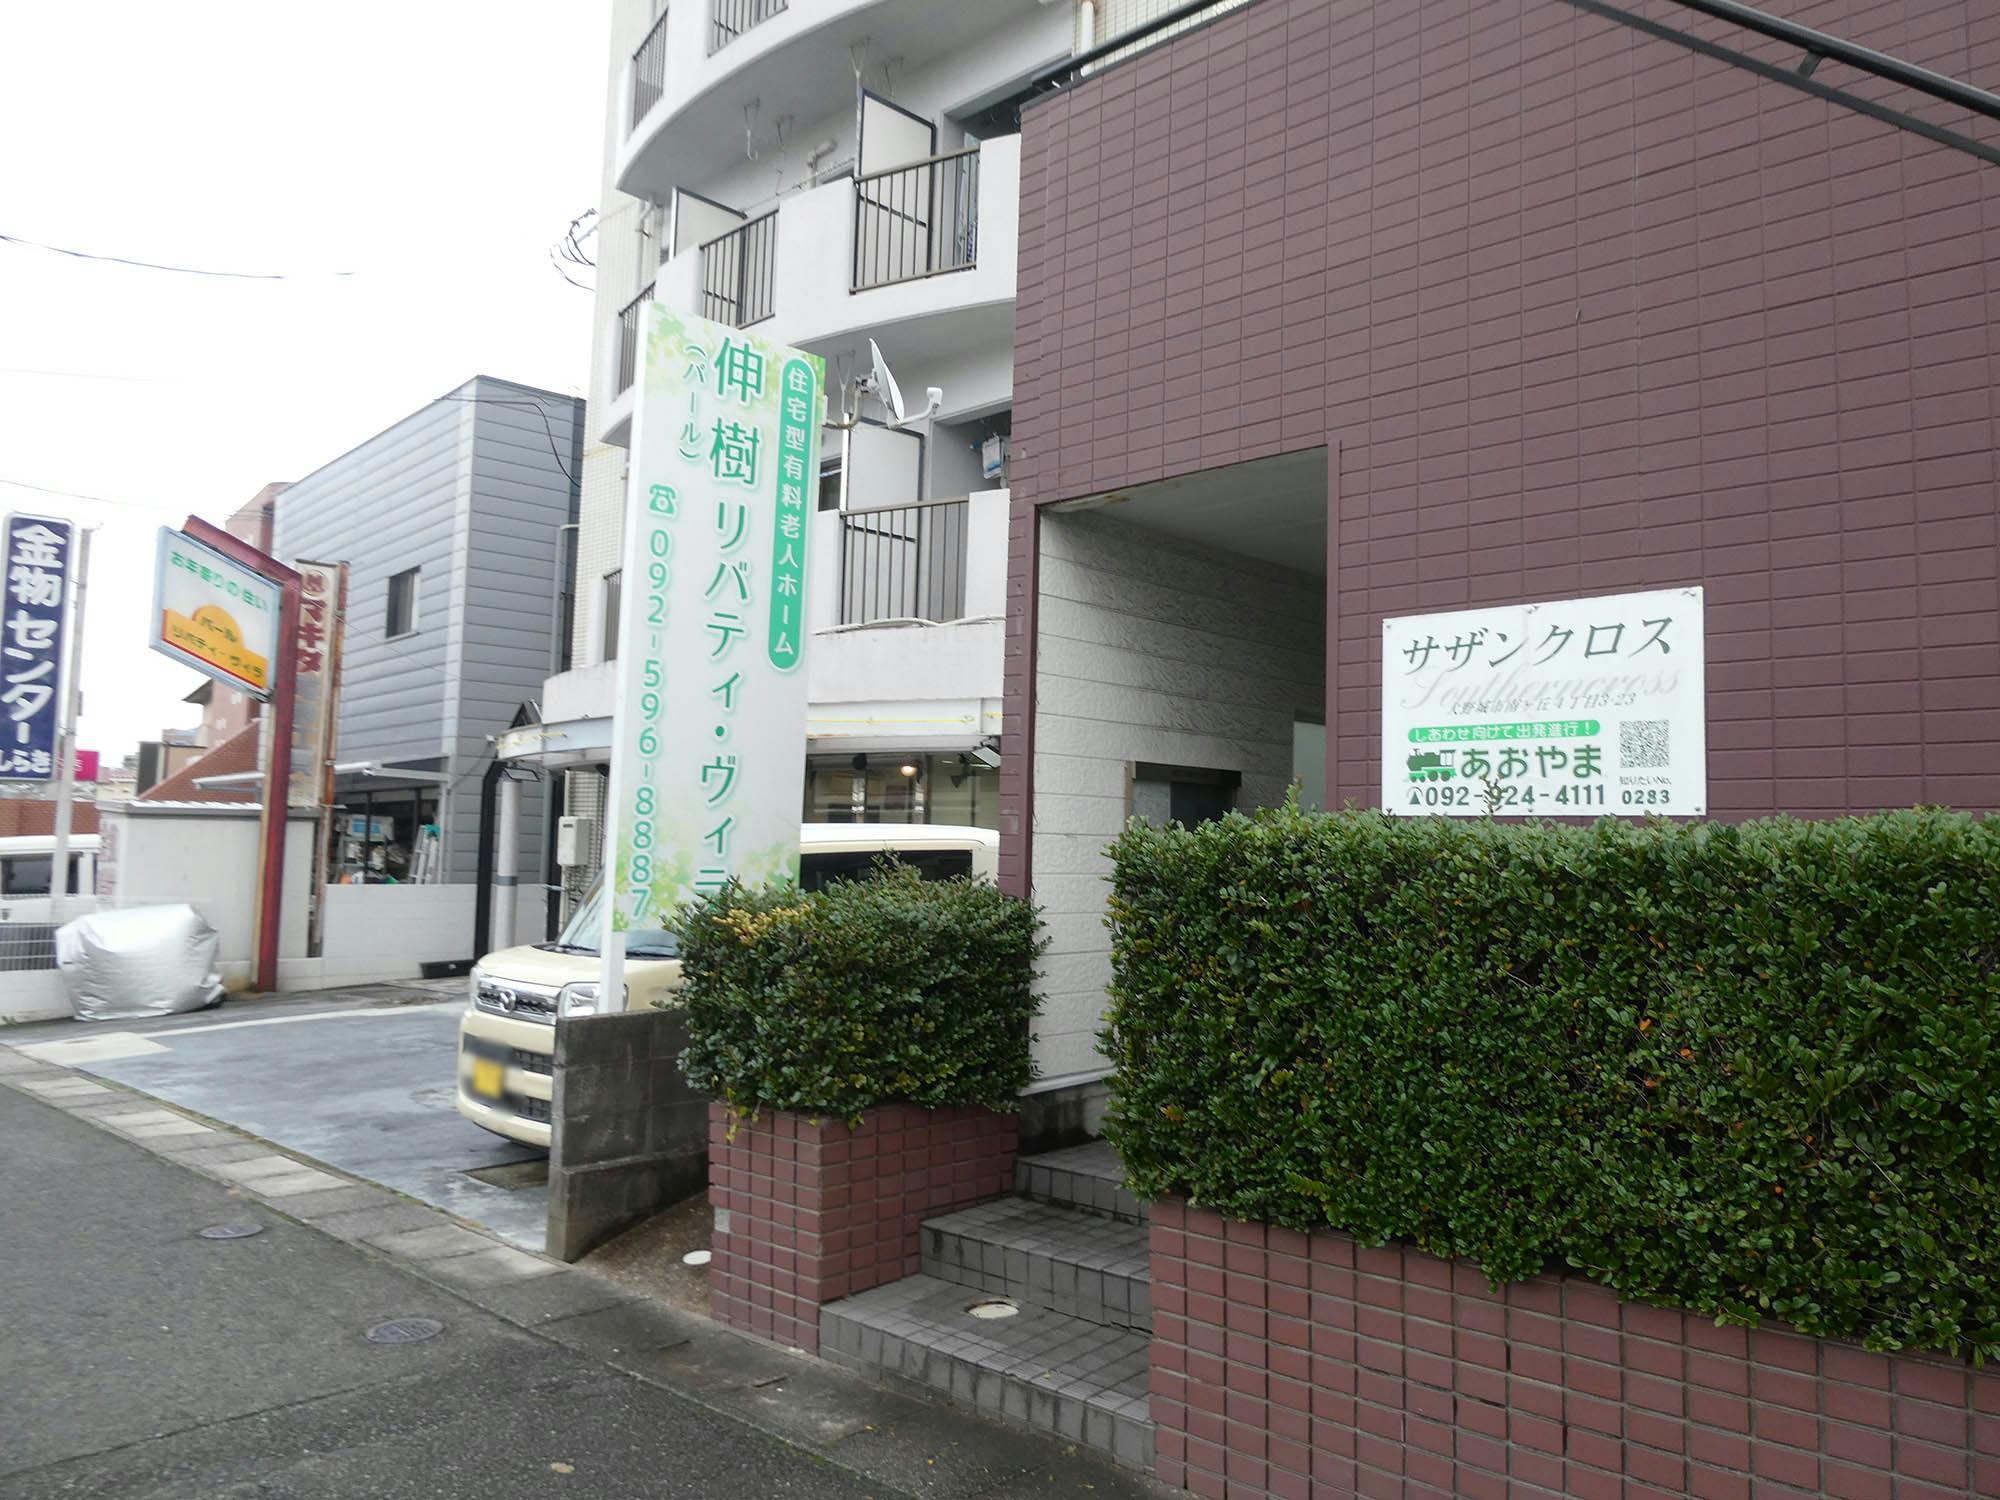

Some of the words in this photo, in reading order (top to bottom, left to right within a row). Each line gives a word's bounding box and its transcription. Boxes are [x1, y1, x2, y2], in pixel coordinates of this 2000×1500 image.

[775, 366, 808, 656] 住宅型有料老人ホーム
[1, 524, 66, 744] 金物センター
[1402, 616, 1674, 676] サザンクロス
[631, 530, 669, 919] 092-596-8887
[1461, 744, 1601, 779] あおやま
[1622, 789, 1670, 805] 0283
